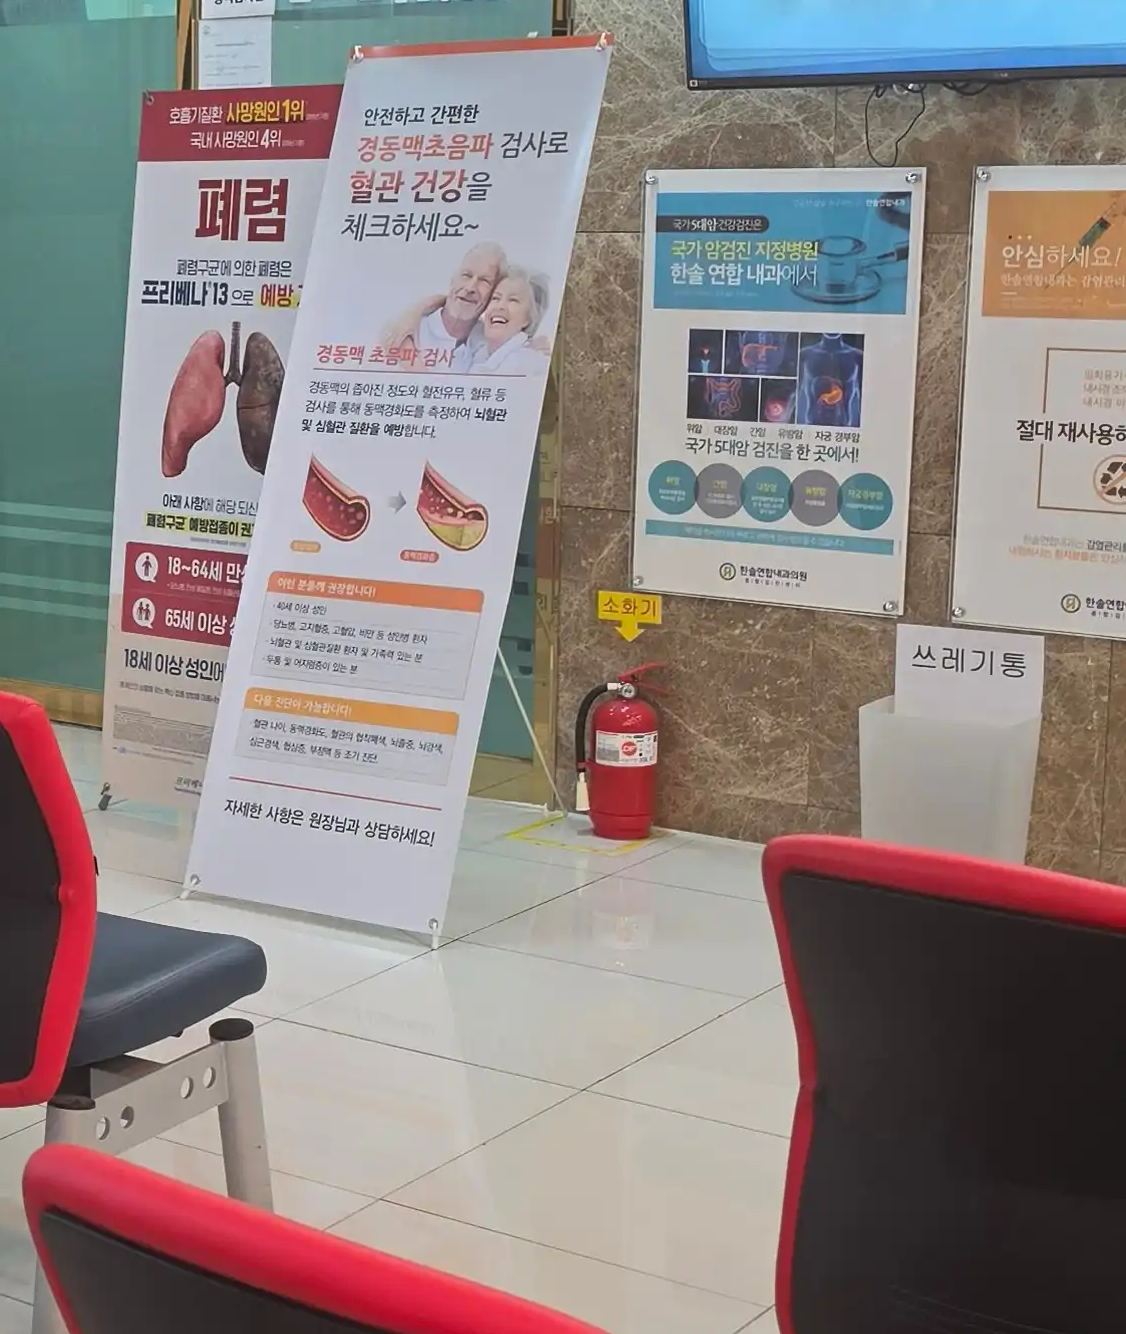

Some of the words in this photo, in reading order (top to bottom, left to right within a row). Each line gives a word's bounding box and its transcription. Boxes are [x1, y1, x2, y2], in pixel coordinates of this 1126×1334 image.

[169, 106, 222, 125] 호흡기질환
[227, 101, 280, 122] 사망원인
[364, 107, 424, 126] 안전하고
[431, 104, 479, 124] 간편한
[190, 132, 213, 149] 국내
[214, 131, 259, 148] 사망원인
[261, 130, 282, 148] 4위
[358, 133, 493, 163] 경동맥초음파
[500, 130, 568, 159] 검사로
[350, 170, 404, 204] 혈관
[411, 169, 492, 203] 건강을
[195, 178, 289, 242] 폐렴
[341, 213, 479, 242] 체크하세요~
[671, 240, 702, 259] 국가
[705, 240, 751, 260] 암검진
[756, 241, 818, 261] 지정병원
[1002, 245, 1122, 268] 안심하세요!
[234, 260, 256, 277] 의한
[670, 263, 705, 284] 한솔
[709, 264, 743, 285] 연합
[747, 263, 817, 286] 내과에서
[317, 344, 364, 364] 경동맥
[369, 346, 418, 365] 초음파
[423, 349, 455, 368] 검사
[1016, 420, 1053, 442] 절대
[685, 438, 712, 454] 국가
[715, 440, 749, 457] 5대암
[753, 442, 792, 460] 검진을
[797, 444, 809, 460] 한
[814, 445, 859, 463] 곳에서!
[167, 555, 223, 580] 18~64세
[603, 596, 657, 618] 소화기
[165, 608, 195, 629] 65세
[198, 613, 226, 635] 이상
[124, 648, 152, 671] 18세
[155, 653, 183, 676] 이상
[912, 643, 1027, 679] 쓰레기통
[224, 800, 262, 819] 자세한
[266, 806, 304, 827] 사항은
[309, 812, 360, 836] 원장님과
[364, 819, 435, 847] 상담하세요!
